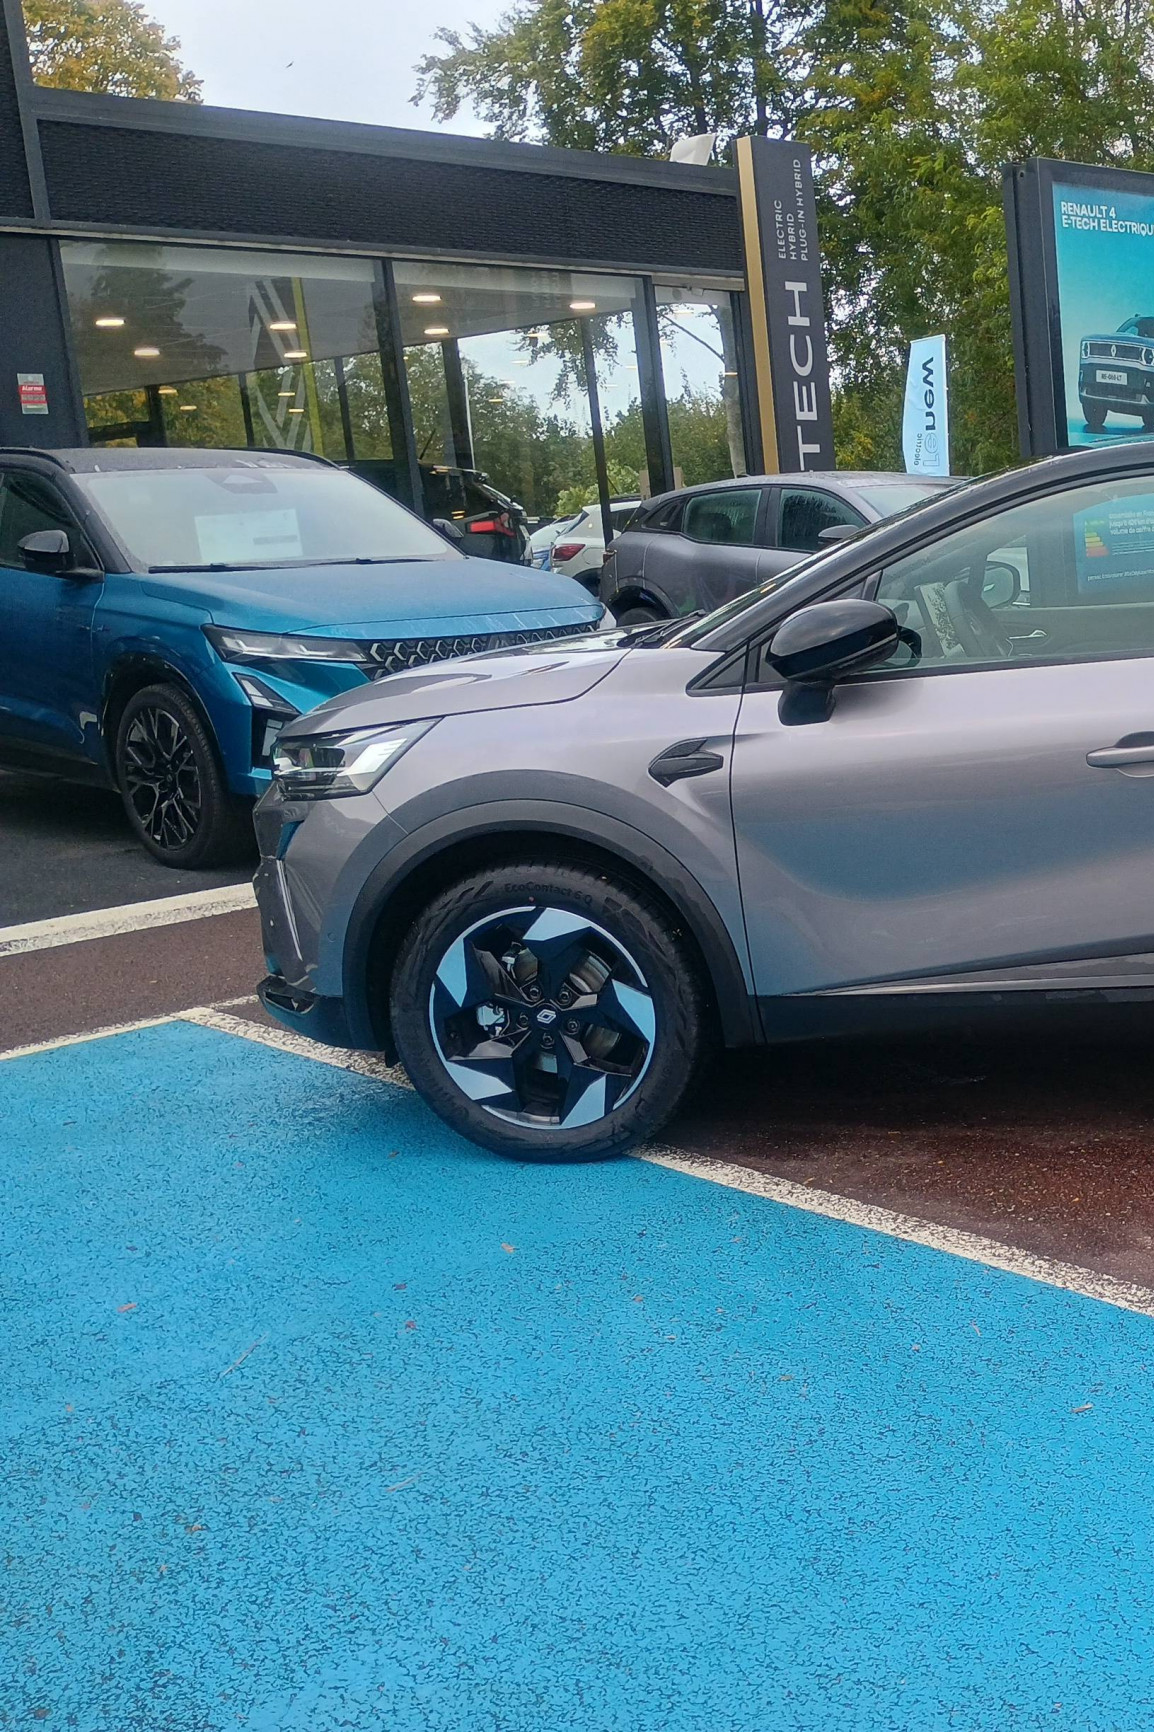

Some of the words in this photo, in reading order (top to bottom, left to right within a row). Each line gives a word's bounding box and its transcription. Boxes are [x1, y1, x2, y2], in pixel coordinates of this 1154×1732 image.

[793, 159, 804, 206] HYBRID
[774, 200, 786, 259] ELECTRIC
[1061, 201, 1108, 218] RENAULT
[1109, 206, 1117, 219] 4
[1062, 215, 1098, 230] E-TECH
[787, 213, 797, 260] HYBRID
[798, 210, 808, 261] PLUG-IN
[784, 280, 821, 471] TECH
[913, 432, 923, 467] electric
[504, 881, 573, 896] EcoContact
[574, 890, 583, 899] 6
